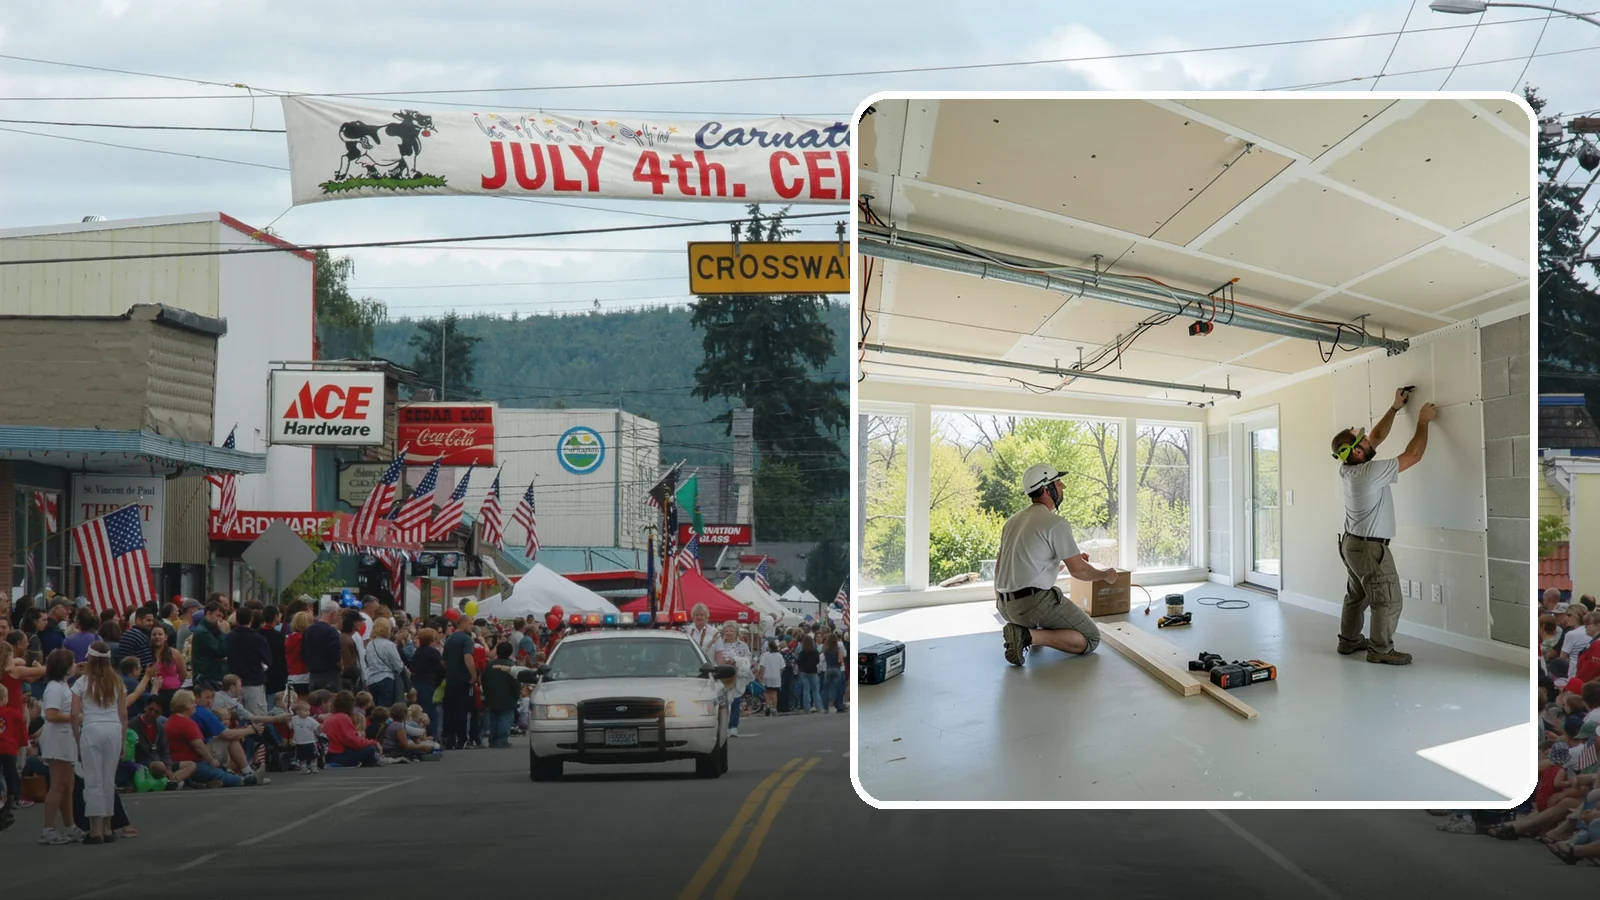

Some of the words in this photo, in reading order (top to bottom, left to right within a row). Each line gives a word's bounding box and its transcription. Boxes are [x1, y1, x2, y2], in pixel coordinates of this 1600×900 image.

[481, 140, 604, 192] JULY
[632, 150, 746, 197] 4th.
[697, 253, 850, 280] CROSSWA
[283, 380, 373, 420] ACE
[405, 409, 452, 421] CEDAR
[283, 420, 371, 437] Hardware
[416, 428, 477, 447] Coca-Cola
[95, 485, 124, 495] Vincent
[126, 485, 136, 495] de
[137, 486, 155, 495] Paul
[213, 516, 330, 535] HARDARE
[688, 526, 741, 534] CRNATION
